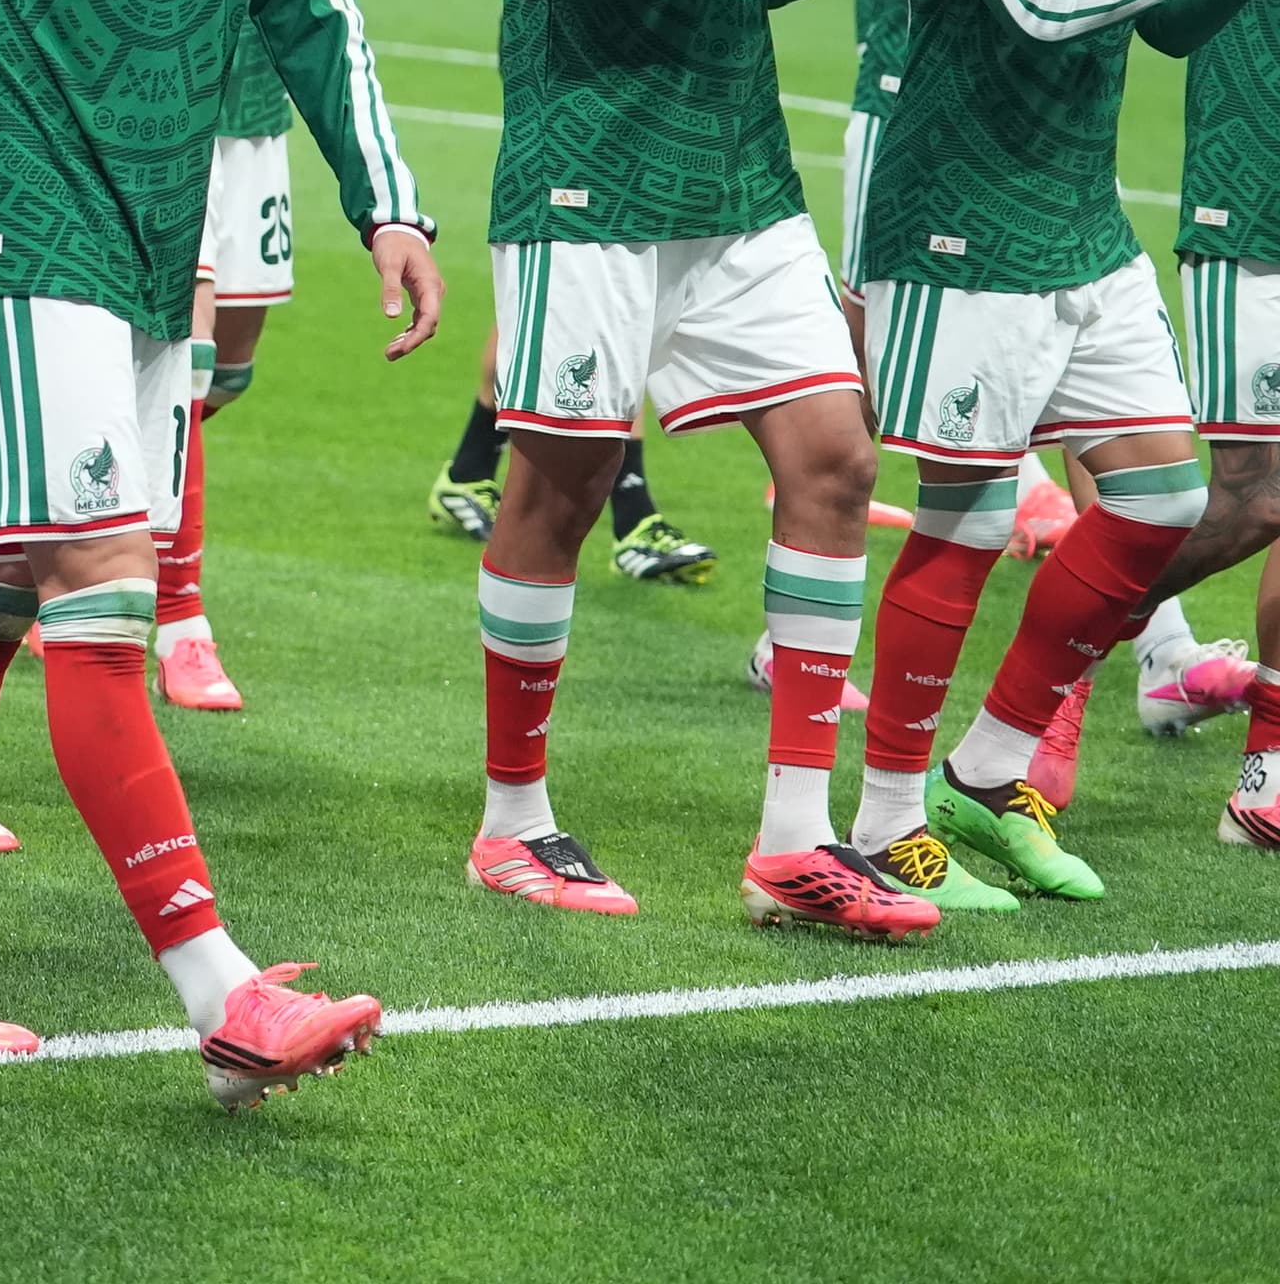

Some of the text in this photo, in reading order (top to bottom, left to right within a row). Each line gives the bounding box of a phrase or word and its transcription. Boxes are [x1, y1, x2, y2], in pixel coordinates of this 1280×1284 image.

[260, 193, 292, 266] 26
[77, 499, 119, 512] MÉXICO
[800, 662, 848, 679] MÉXI
